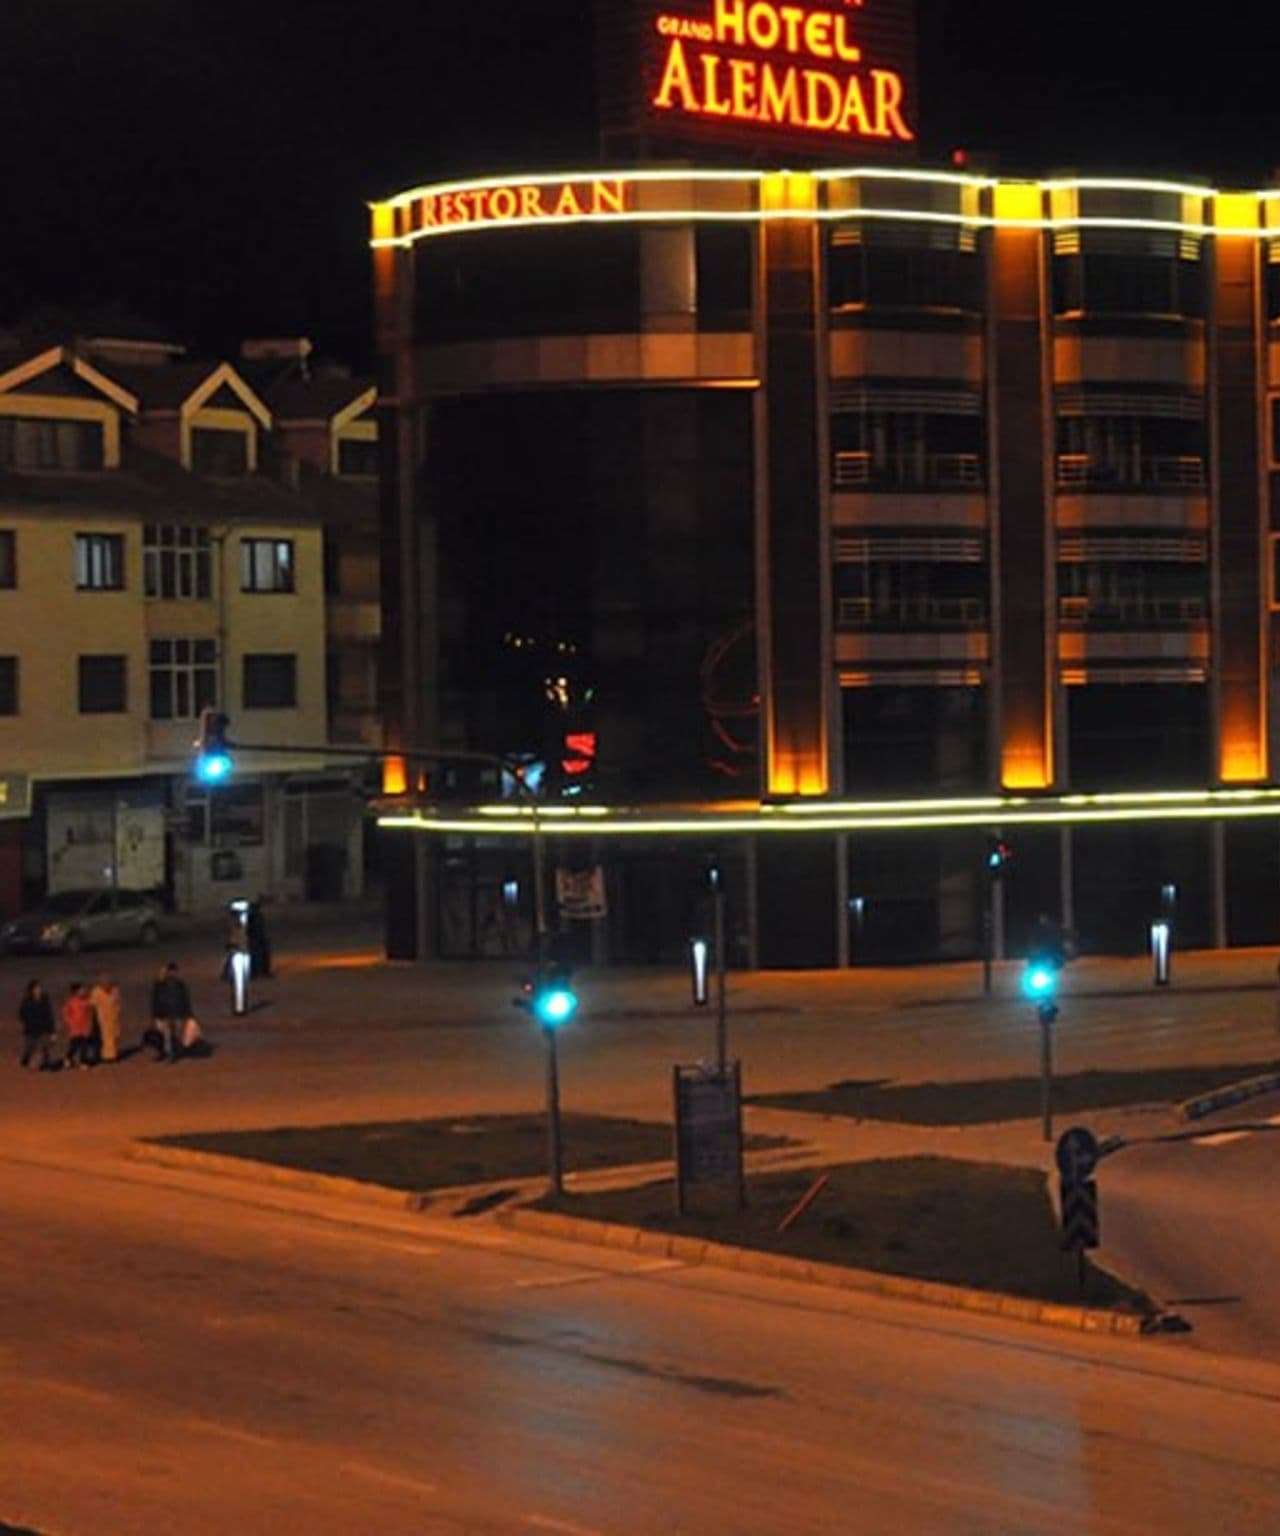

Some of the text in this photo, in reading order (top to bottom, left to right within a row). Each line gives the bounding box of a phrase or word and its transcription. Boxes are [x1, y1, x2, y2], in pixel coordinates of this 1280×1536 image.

[657, 0, 861, 62] GRAND HOTEL
[652, 37, 915, 140] ALEMDAR
[419, 178, 627, 230] RESTORAN
